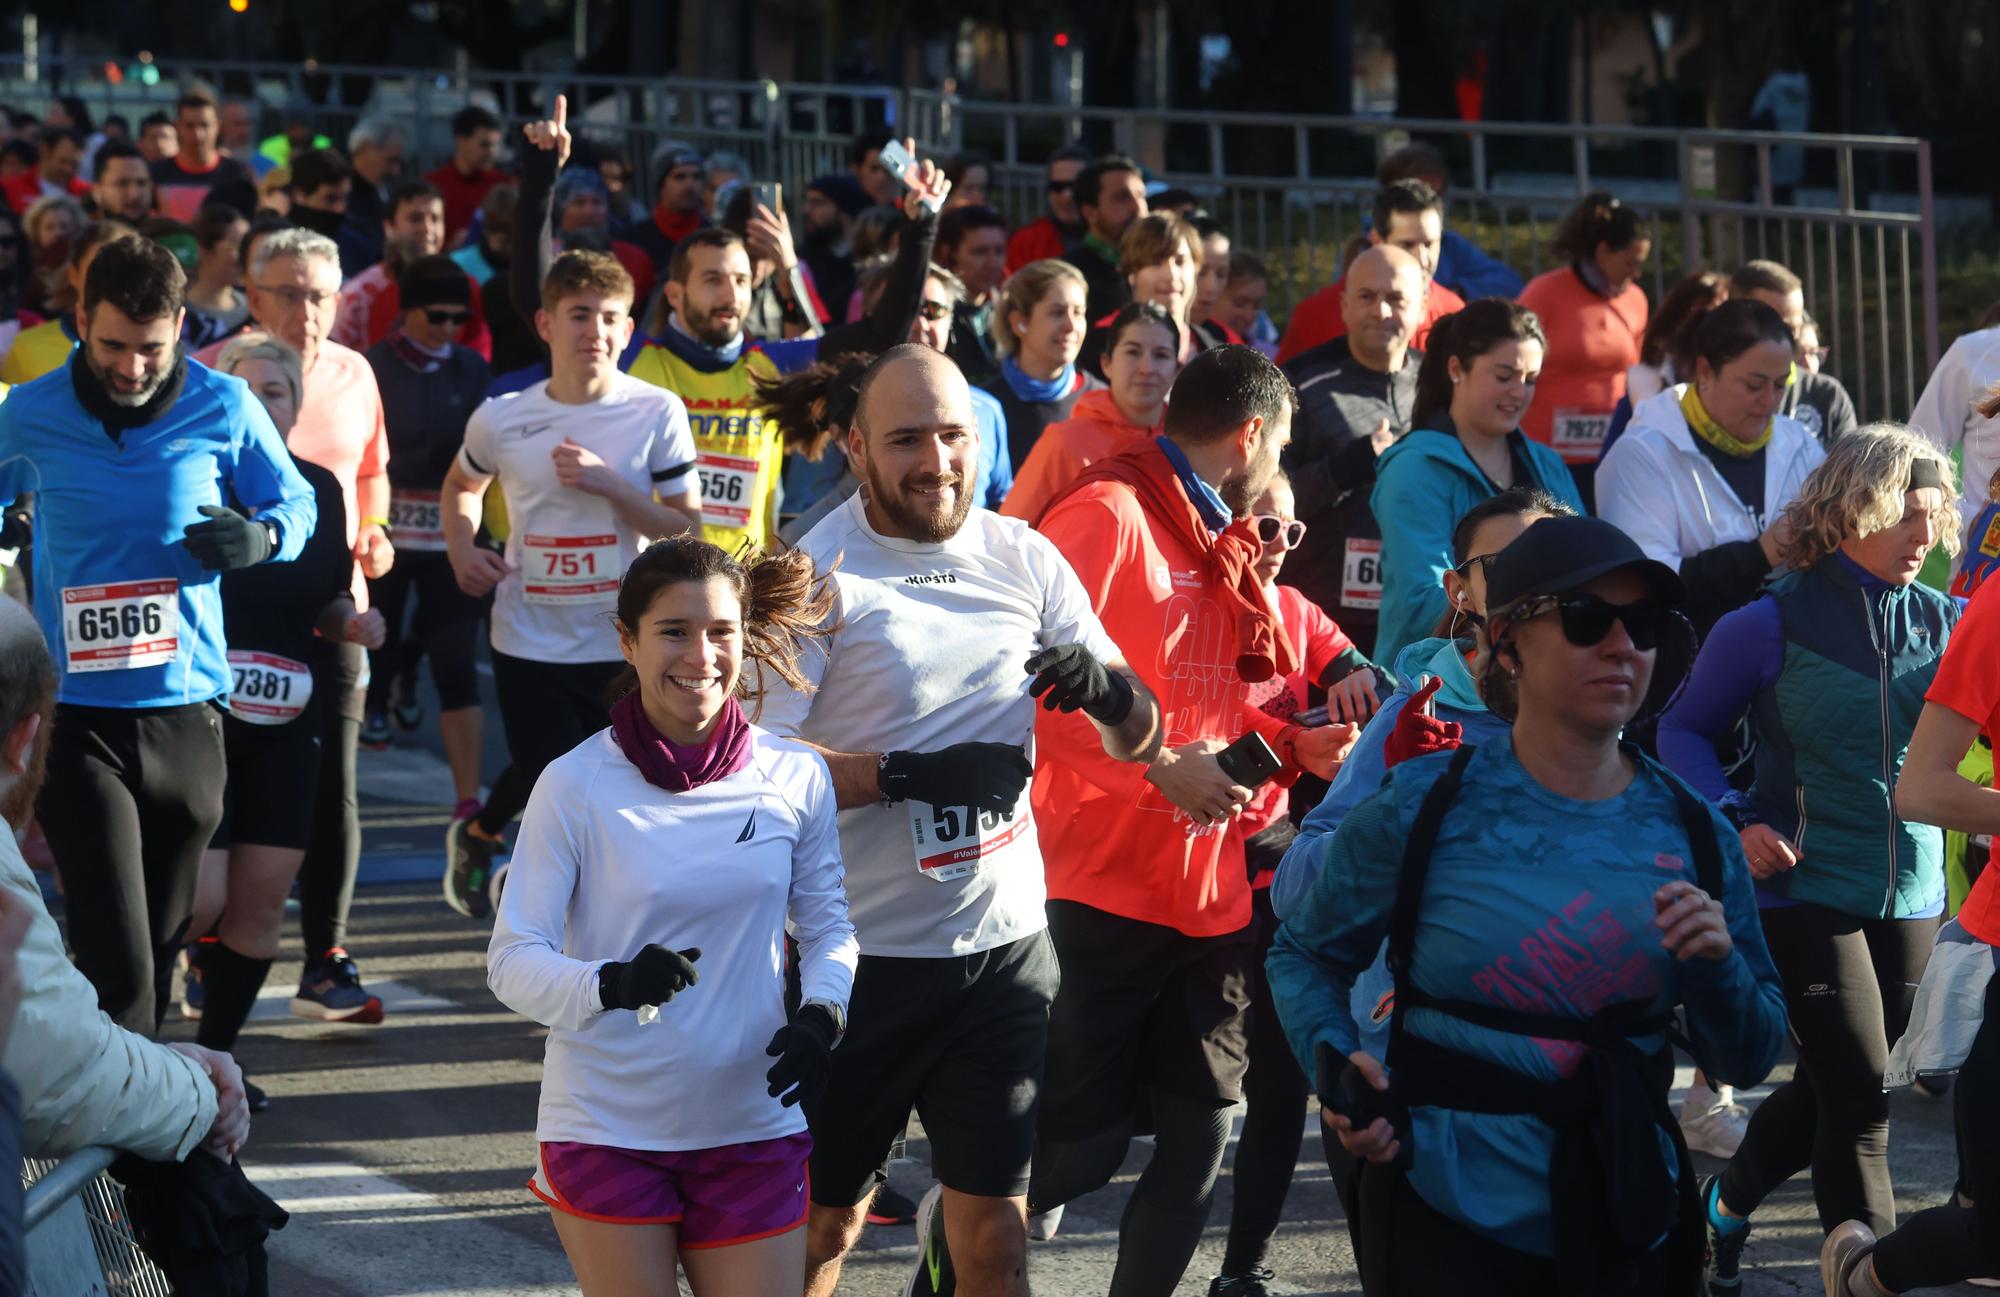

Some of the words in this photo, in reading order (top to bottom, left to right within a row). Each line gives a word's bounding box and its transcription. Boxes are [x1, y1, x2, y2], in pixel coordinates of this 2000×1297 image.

[543, 552, 596, 576] 751
[78, 602, 161, 642] 6566
[233, 668, 291, 702] 7381
